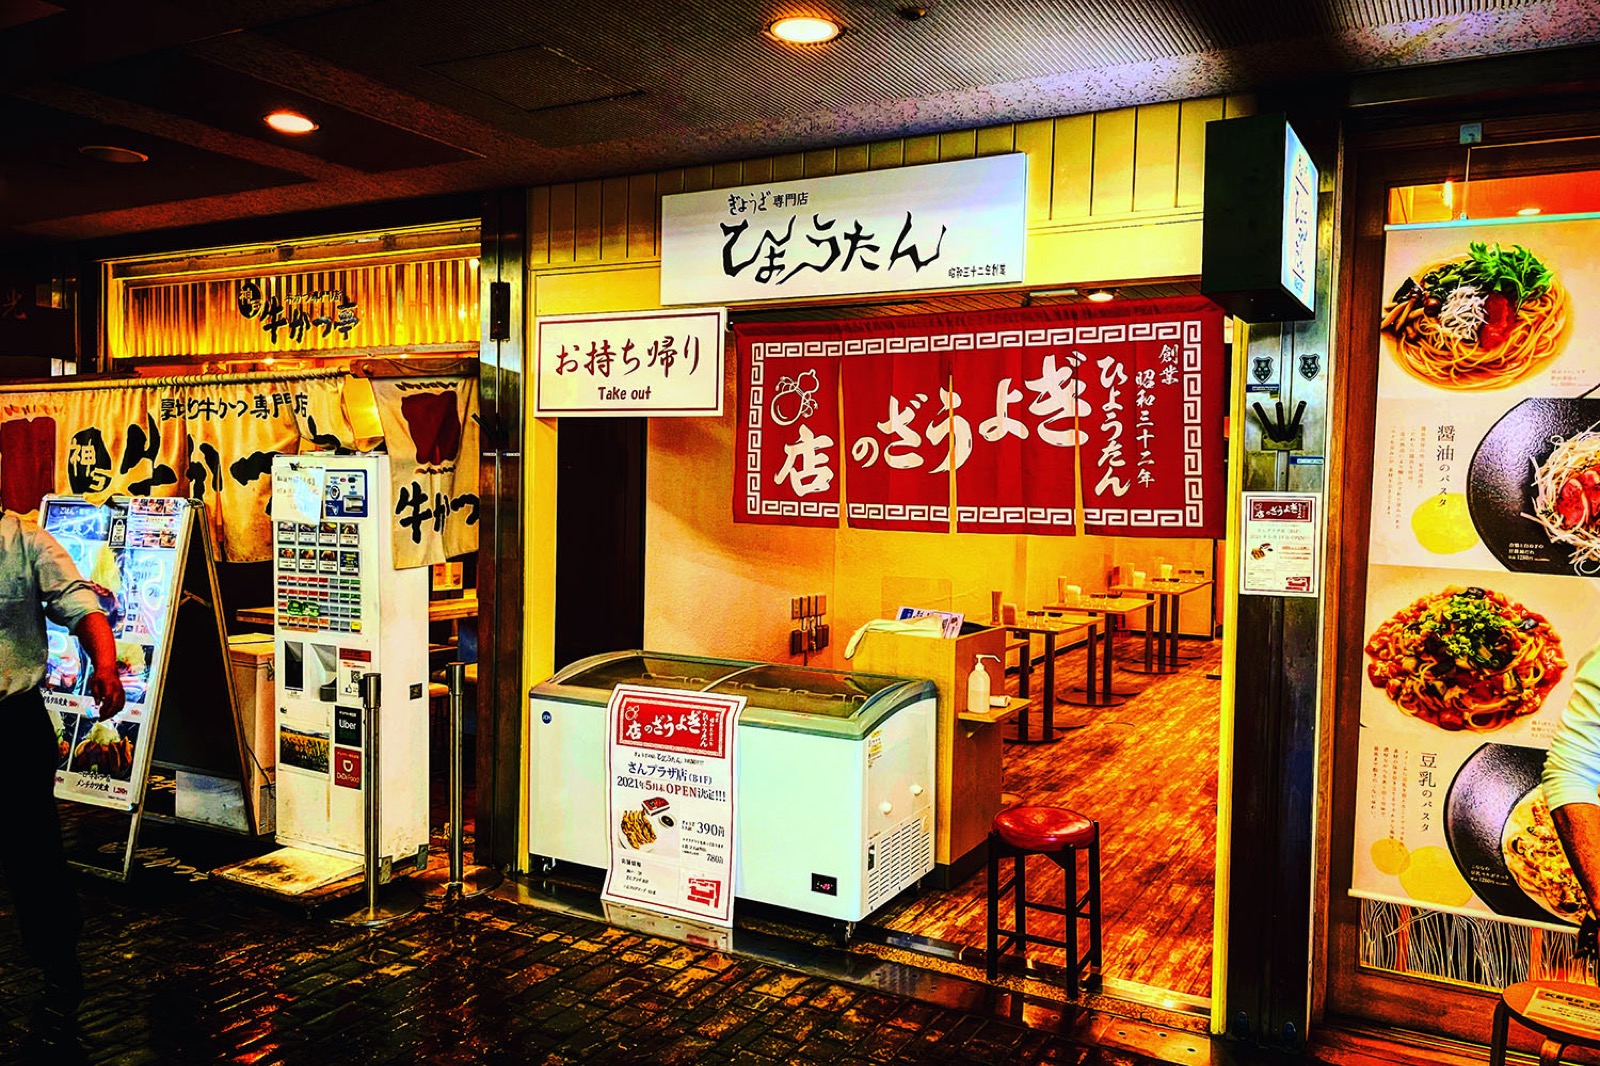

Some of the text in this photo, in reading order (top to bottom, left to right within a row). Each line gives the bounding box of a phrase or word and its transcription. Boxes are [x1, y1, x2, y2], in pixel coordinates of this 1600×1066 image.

[720, 211, 946, 285] ひょうたん
[555, 335, 700, 378] お持ち帰り
[598, 386, 651, 400] Take out
[1158, 343, 1179, 385] 創業
[1135, 368, 1156, 488] 昭和三十二年
[1437, 425, 1455, 507] 醤油のパスタ
[1418, 752, 1437, 832] 豆乳のパスタ
